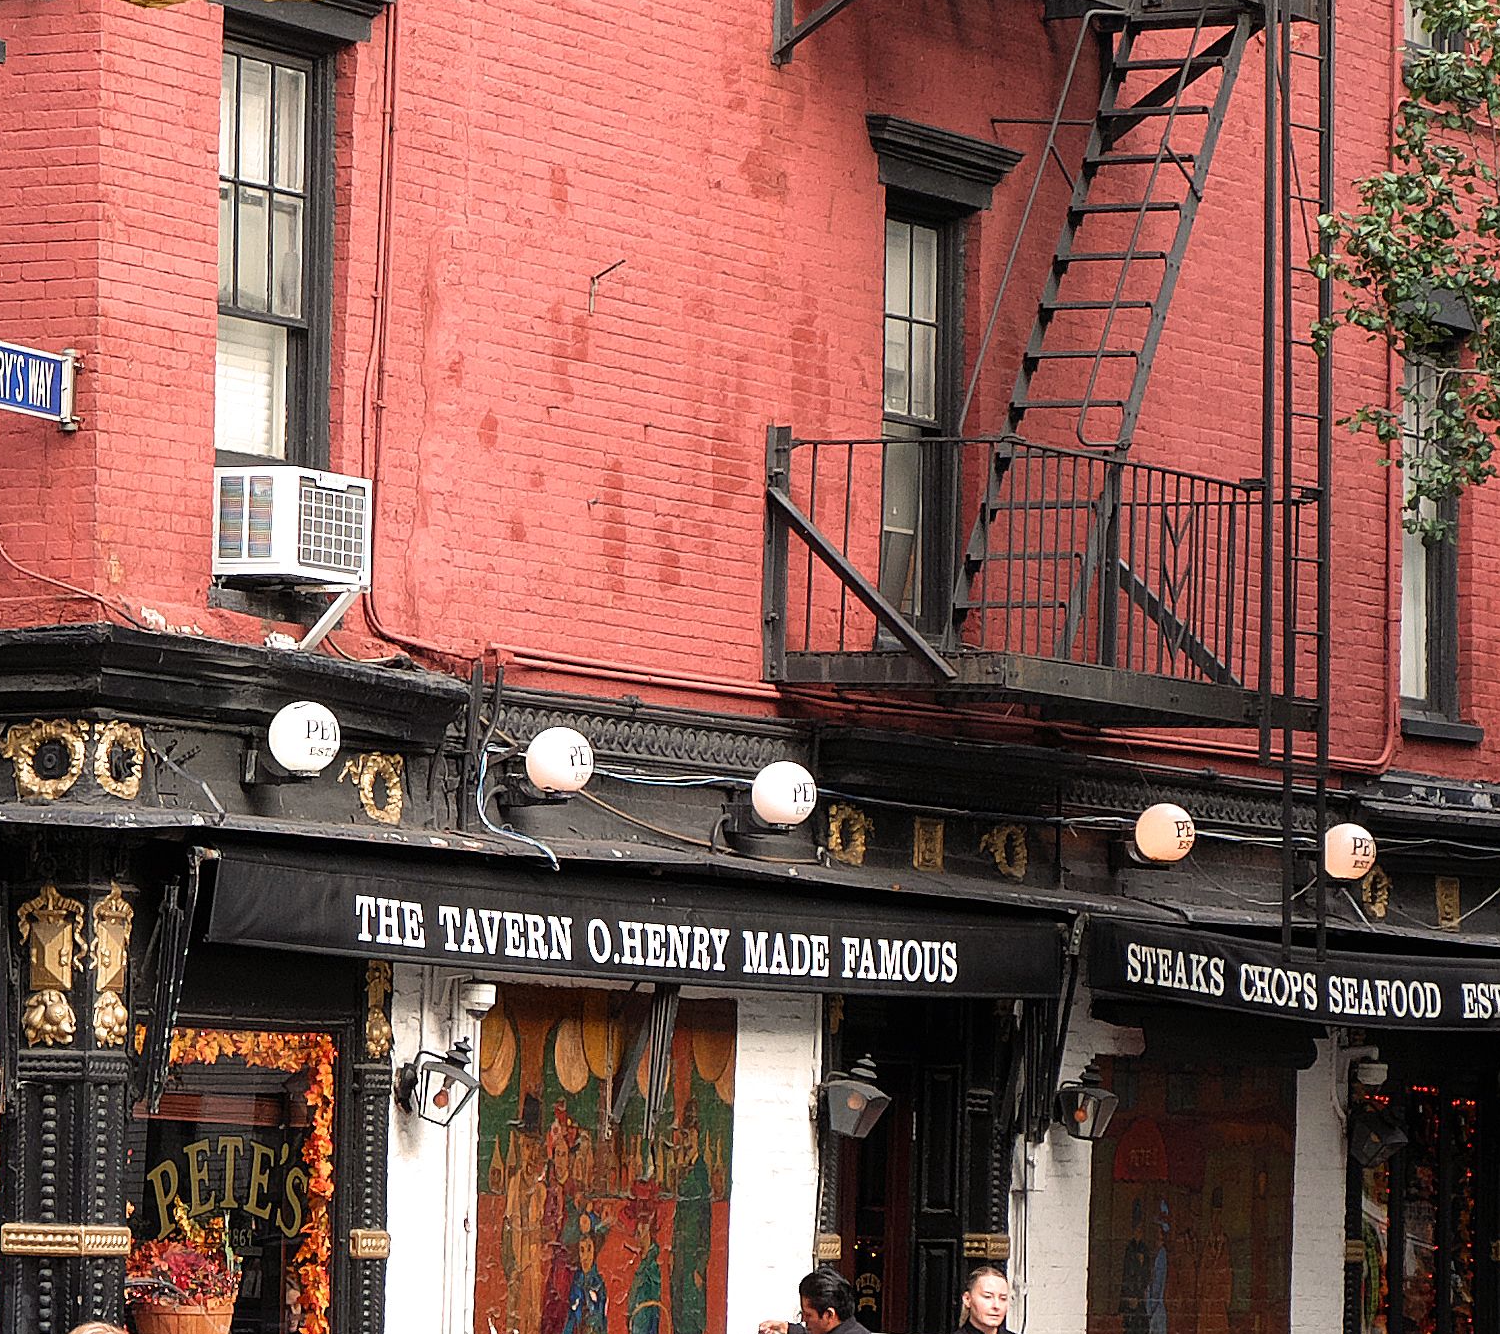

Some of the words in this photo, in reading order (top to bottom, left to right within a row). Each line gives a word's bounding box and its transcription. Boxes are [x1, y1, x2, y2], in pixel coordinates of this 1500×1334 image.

[27, 355, 56, 409] WAY
[355, 894, 426, 949] THE
[438, 904, 573, 962] TAVERN
[587, 918, 731, 972] O.HENRY
[742, 929, 830, 979] MADE
[841, 936, 958, 984] FAMOUS
[1127, 942, 1225, 997] STEAKS
[1239, 963, 1319, 1011] CHOPS
[1328, 975, 1442, 1019] SEAFOOD
[147, 1136, 308, 1241] PETE'S
